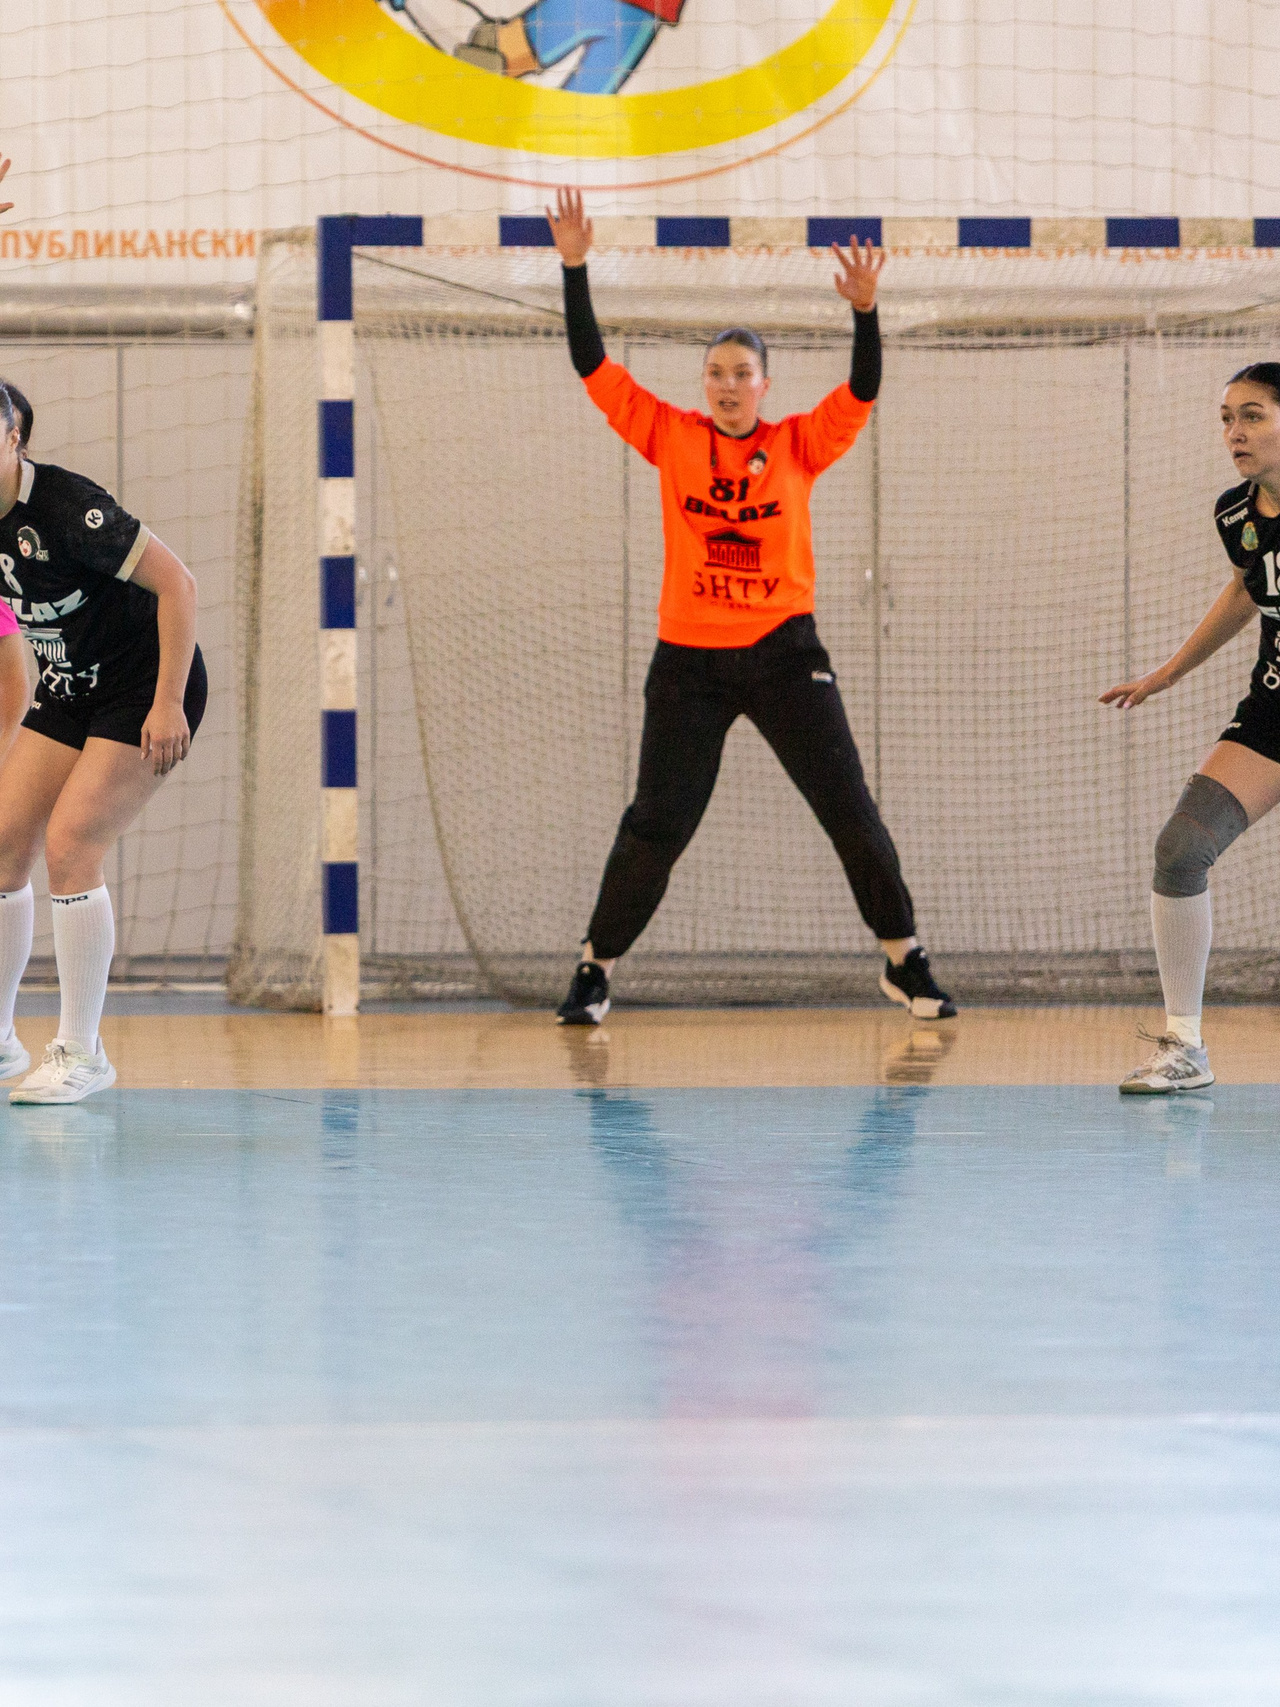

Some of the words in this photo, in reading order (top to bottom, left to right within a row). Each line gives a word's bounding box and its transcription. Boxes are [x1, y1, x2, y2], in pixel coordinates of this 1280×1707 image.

[709, 476, 750, 502] 81
[1262, 551, 1280, 596] 1
[0, 588, 89, 623] LAZ
